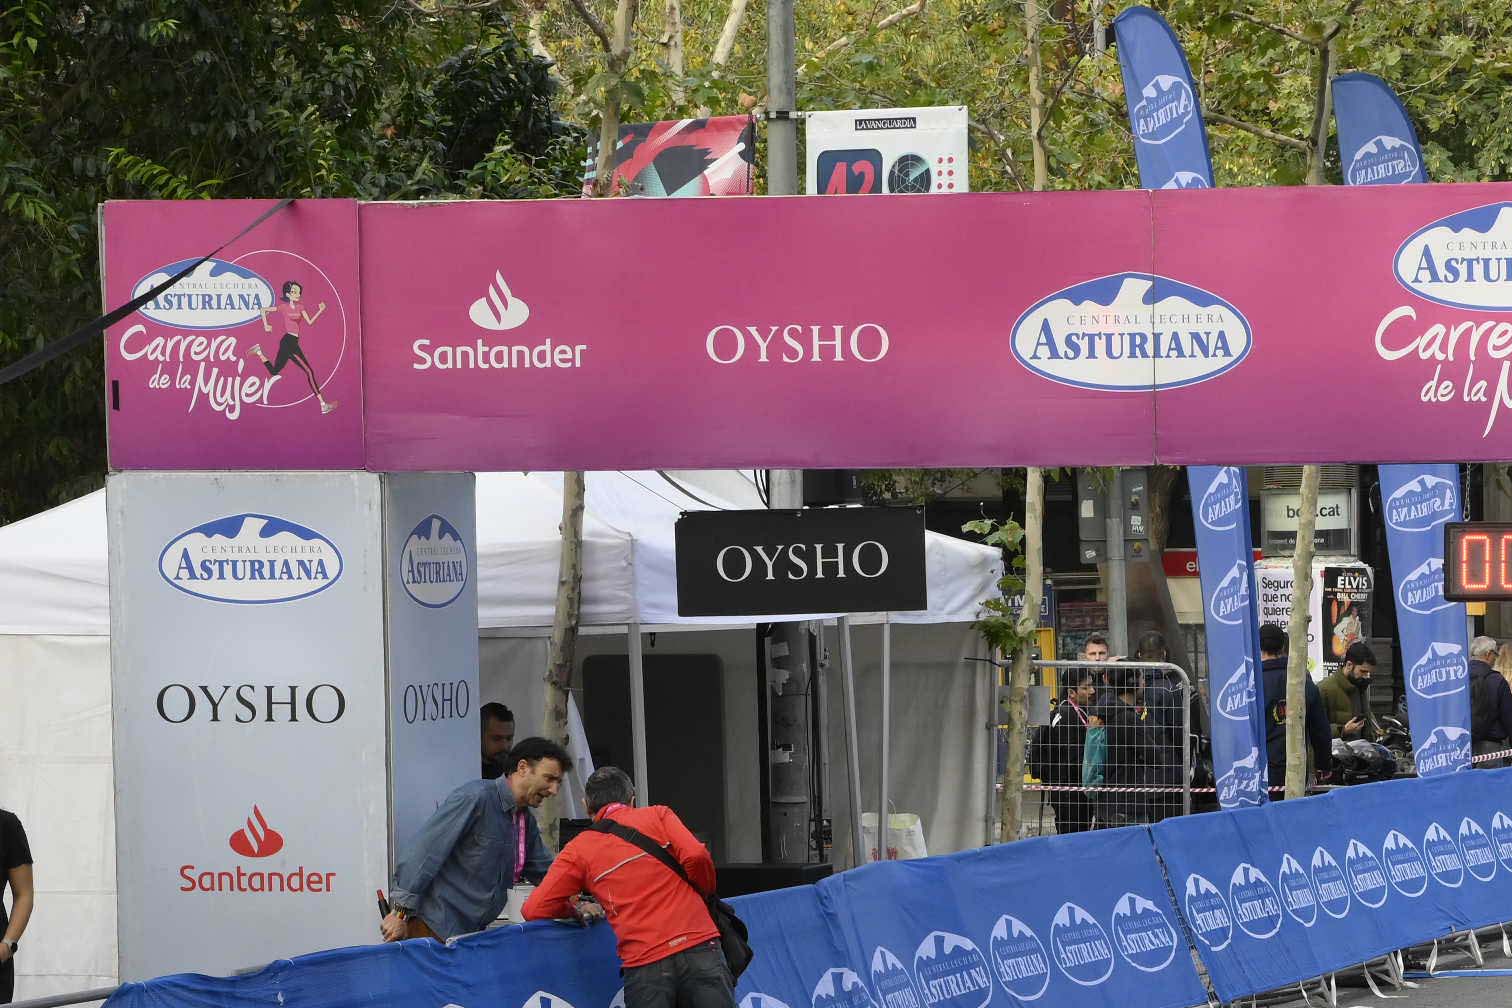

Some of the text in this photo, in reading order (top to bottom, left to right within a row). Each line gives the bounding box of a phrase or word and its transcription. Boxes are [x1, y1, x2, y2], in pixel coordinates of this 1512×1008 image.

[1066, 312, 1225, 325] CENTRAL LECHERA
[119, 324, 237, 361] Carrera
[412, 337, 588, 370] Santander
[706, 323, 890, 365] OYSHO
[1030, 318, 1232, 361] ASTURIANA
[149, 359, 282, 420] de la Mujer
[1421, 363, 1455, 402] de
[1463, 362, 1487, 402] la
[174, 548, 329, 580] ASTURIANA
[201, 545, 323, 554] CENTRAL LECHERA
[405, 549, 464, 585] ASTURIANA
[716, 540, 889, 582] OYSHO
[1337, 576, 1368, 588] ELVIS
[1263, 606, 1292, 617] quiere
[156, 684, 346, 723] OYSHO
[403, 679, 470, 724] OYSHO
[180, 865, 336, 893] Santander
